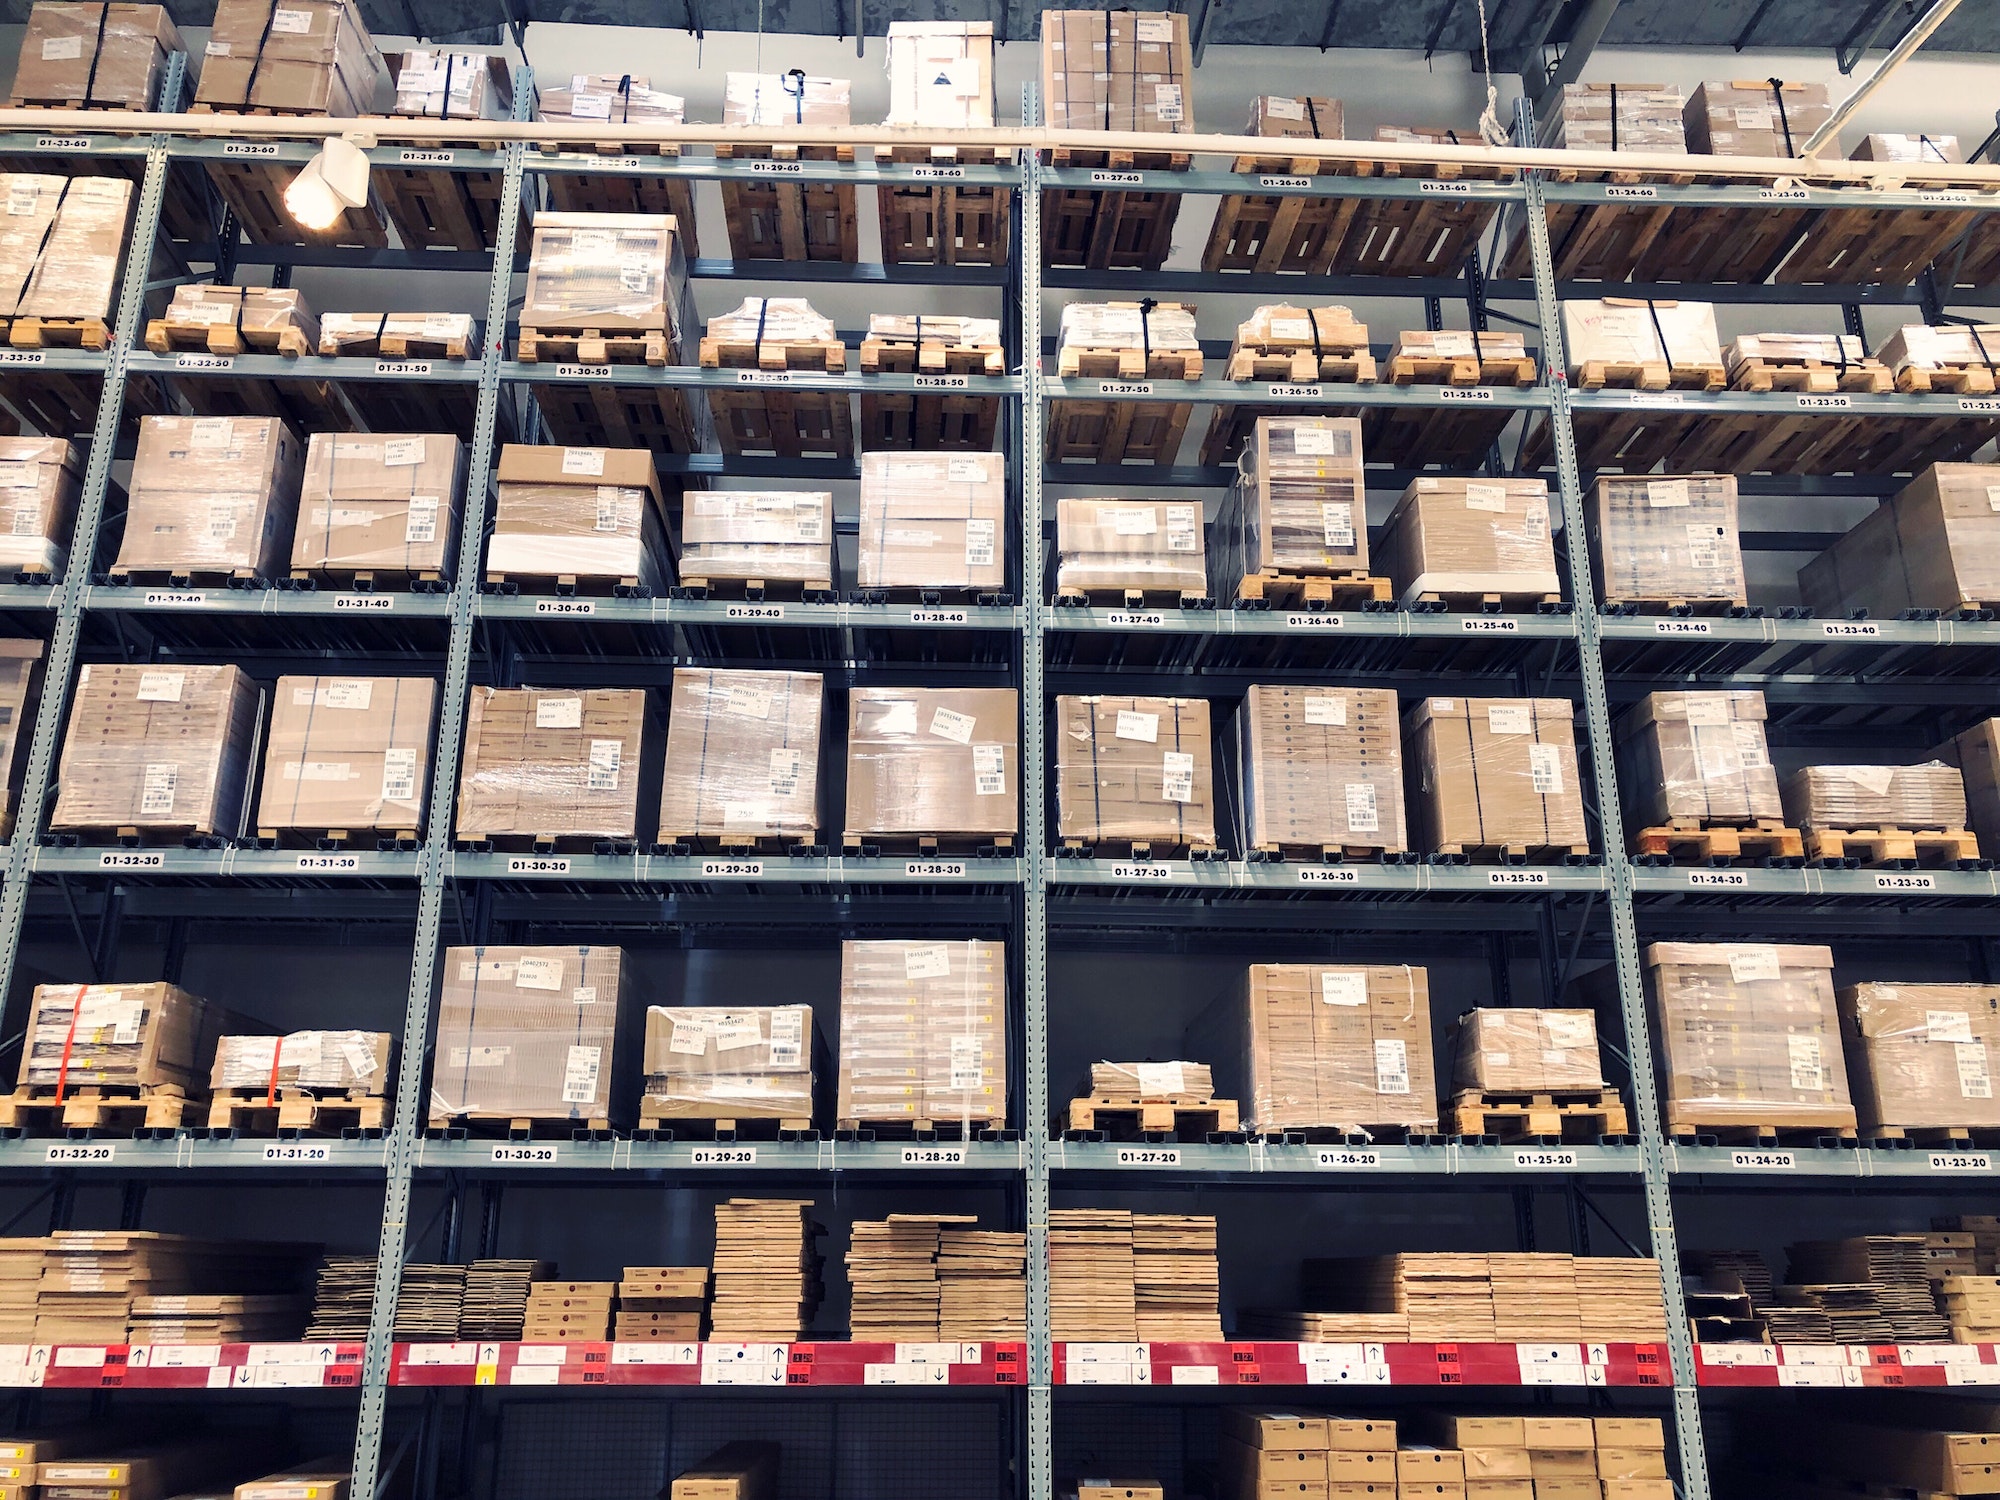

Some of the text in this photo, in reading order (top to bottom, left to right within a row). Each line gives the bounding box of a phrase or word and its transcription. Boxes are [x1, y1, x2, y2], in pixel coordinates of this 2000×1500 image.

[39, 139, 88, 148] 01-33-60
[226, 145, 276, 154] 01-32-60
[402, 152, 451, 162] 01-31-60
[753, 163, 800, 172] 01-29-60
[914, 169, 962, 177] 01-28-60
[1093, 173, 1140, 182] 01-27-60
[1262, 178, 1308, 187] 01-26-60
[1422, 183, 1468, 192] 01-25-60
[1607, 188, 1654, 197] 01-24-60
[1761, 190, 1807, 199] 01-23-60
[178, 359, 230, 368] 01-32-50
[378, 364, 428, 373] 01-31-50
[558, 367, 609, 377] 01-30-50
[915, 377, 965, 387] 01-28-50
[1101, 384, 1150, 394] 01-27-50
[1271, 387, 1319, 396] 01-26-50
[1442, 390, 1490, 399] 01-25-50
[1799, 398, 1847, 406] 01-23-50
[336, 599, 390, 608] 01-31-40
[538, 603, 591, 613] 01-30-40
[729, 608, 781, 618] 01-29-40
[913, 613, 964, 622] 01-28-40
[1110, 615, 1161, 624] 01-27-40
[1289, 617, 1340, 626] 01-26-40
[1464, 621, 1515, 630] 01-25-40
[1658, 623, 1708, 632] 01-24-40
[1825, 626, 1876, 635] 01-23-40
[103, 855, 160, 866] 01-32-30
[300, 858, 355, 868] 01-31-30
[511, 861, 567, 871] 01-30-30
[705, 864, 760, 874] 01-29-30
[908, 864, 961, 875] 01-28-30
[1114, 867, 1167, 878] 01-27-30
[1301, 871, 1354, 881] 01-26-30
[1491, 873, 1544, 883] 01-25-30
[1691, 874, 1743, 885] 01-24-30
[1877, 878, 1930, 888] 01-23-30
[50, 1148, 110, 1159] 01-32-20
[266, 1148, 325, 1159] 01-31-20
[494, 1149, 552, 1160] 01-30-20
[694, 1152, 752, 1162] 01-29-20
[904, 1151, 961, 1162] 01-28-20
[1120, 1152, 1177, 1163] 01-27-20
[1320, 1153, 1376, 1165] 01-26-20
[1517, 1154, 1573, 1165] 01-25-20
[1735, 1155, 1791, 1166] 01-24-20
[1932, 1157, 1987, 1168] 01-23-20
